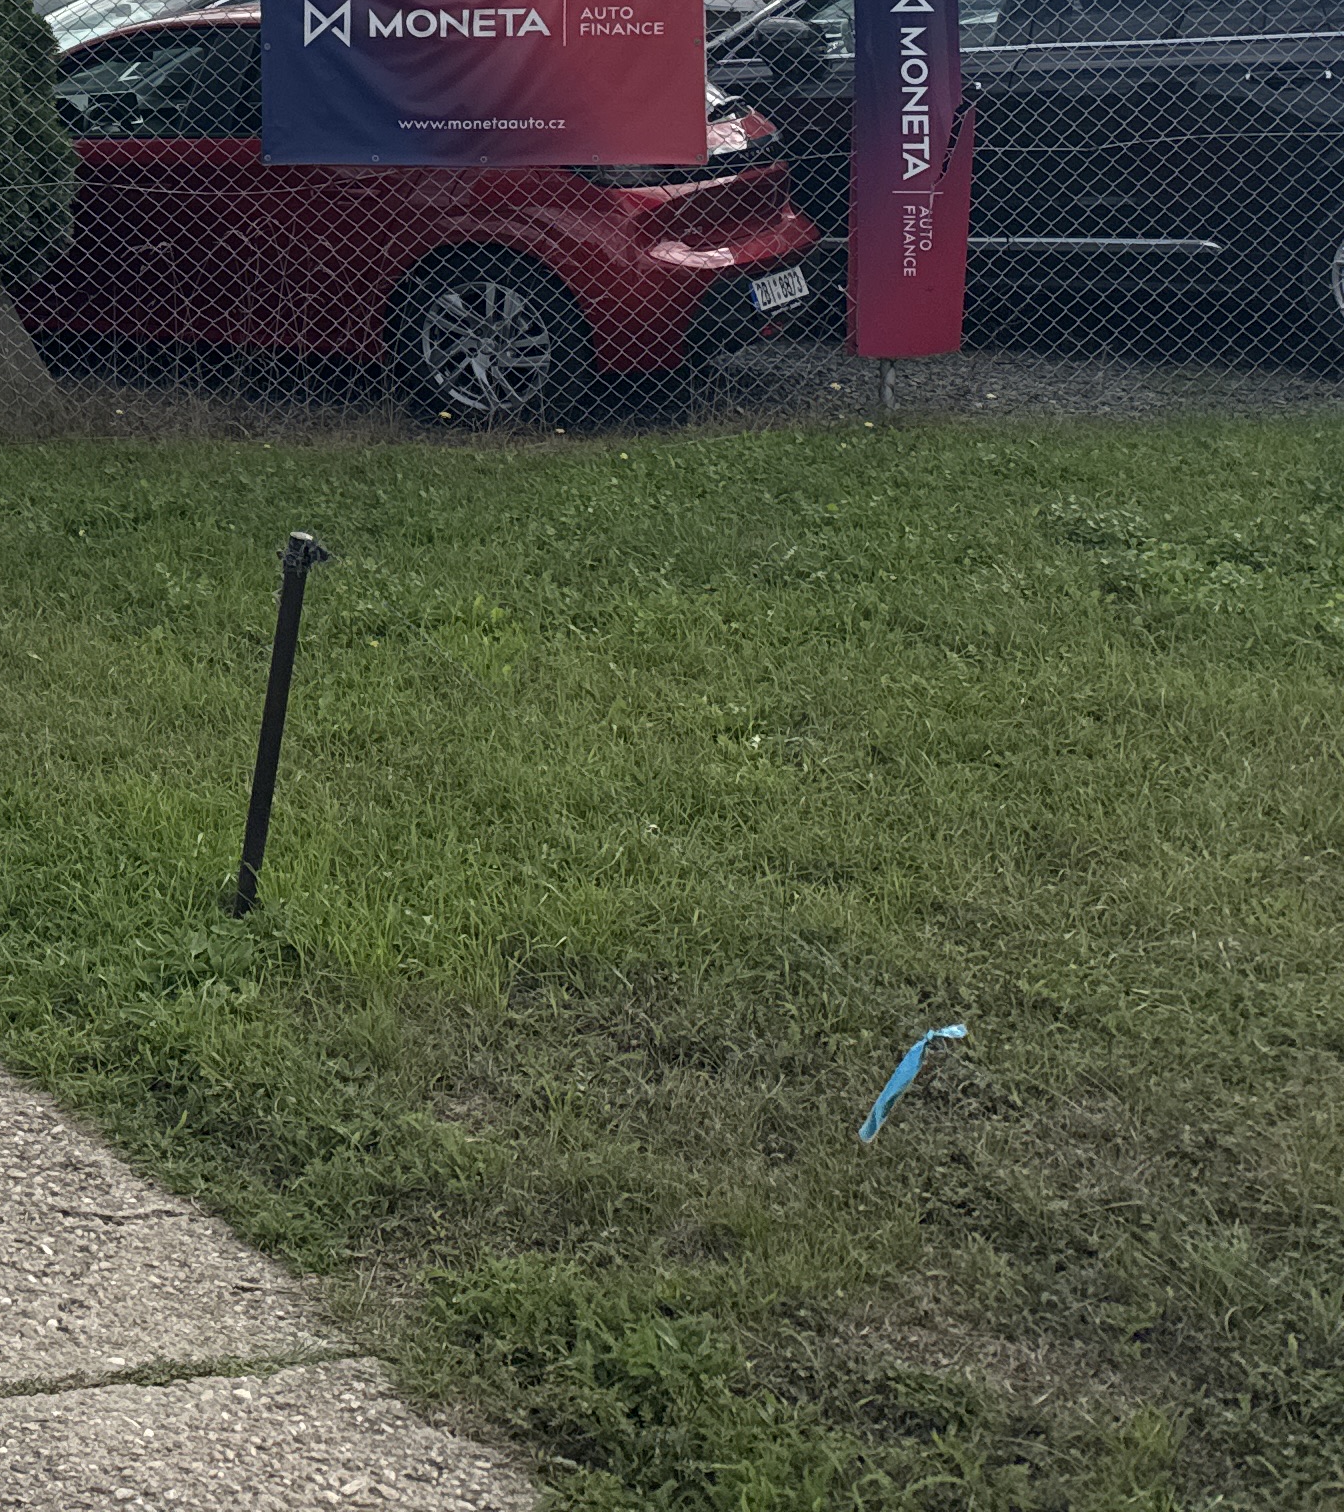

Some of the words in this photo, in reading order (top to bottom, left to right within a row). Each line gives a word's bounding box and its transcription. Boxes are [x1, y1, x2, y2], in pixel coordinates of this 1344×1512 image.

[369, 7, 551, 38] MONETA
[580, 6, 634, 20] AUTO
[580, 22, 665, 36] FINANCE
[900, 26, 930, 181] MONETA
[398, 117, 566, 130] www.monetaauto.cz
[903, 205, 916, 277] FINANCE
[919, 206, 932, 251] AUTO
